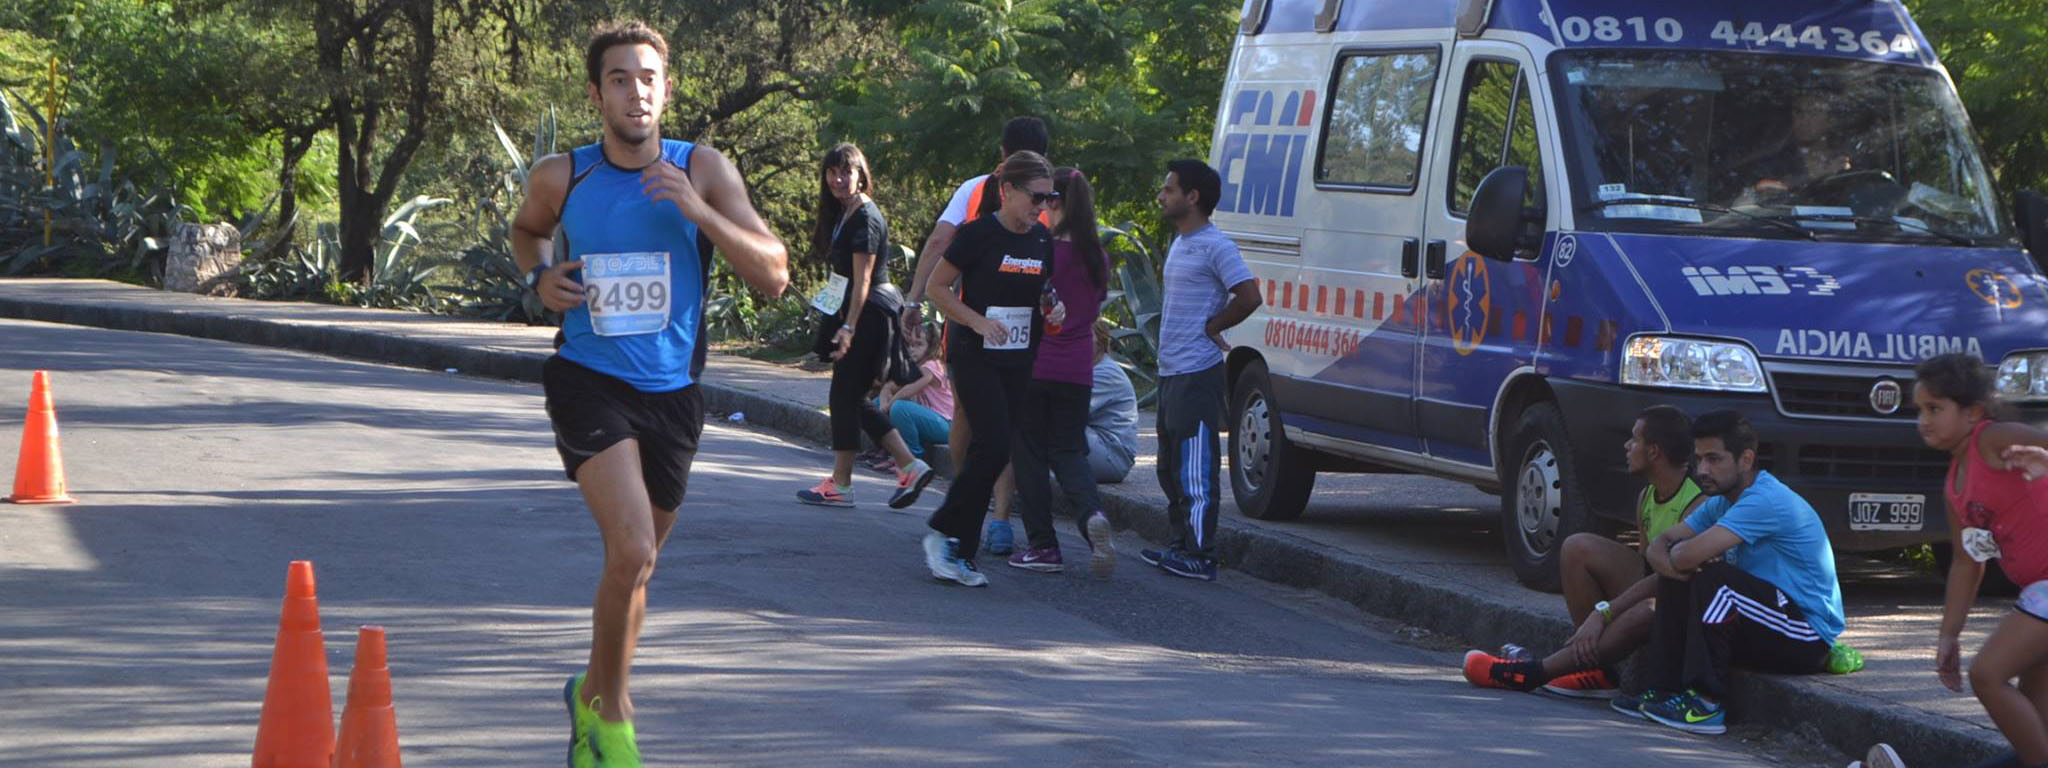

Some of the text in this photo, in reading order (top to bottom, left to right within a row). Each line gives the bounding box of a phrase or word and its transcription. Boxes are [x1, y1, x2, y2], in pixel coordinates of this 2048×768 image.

[1561, 16, 1917, 58] 0810 4444364
[1216, 89, 1317, 217] EMI
[1558, 243, 1573, 259] 82
[585, 281, 666, 313] 2499
[1878, 389, 1896, 406] FIAT
[1853, 502, 1921, 524] JOZ 999
